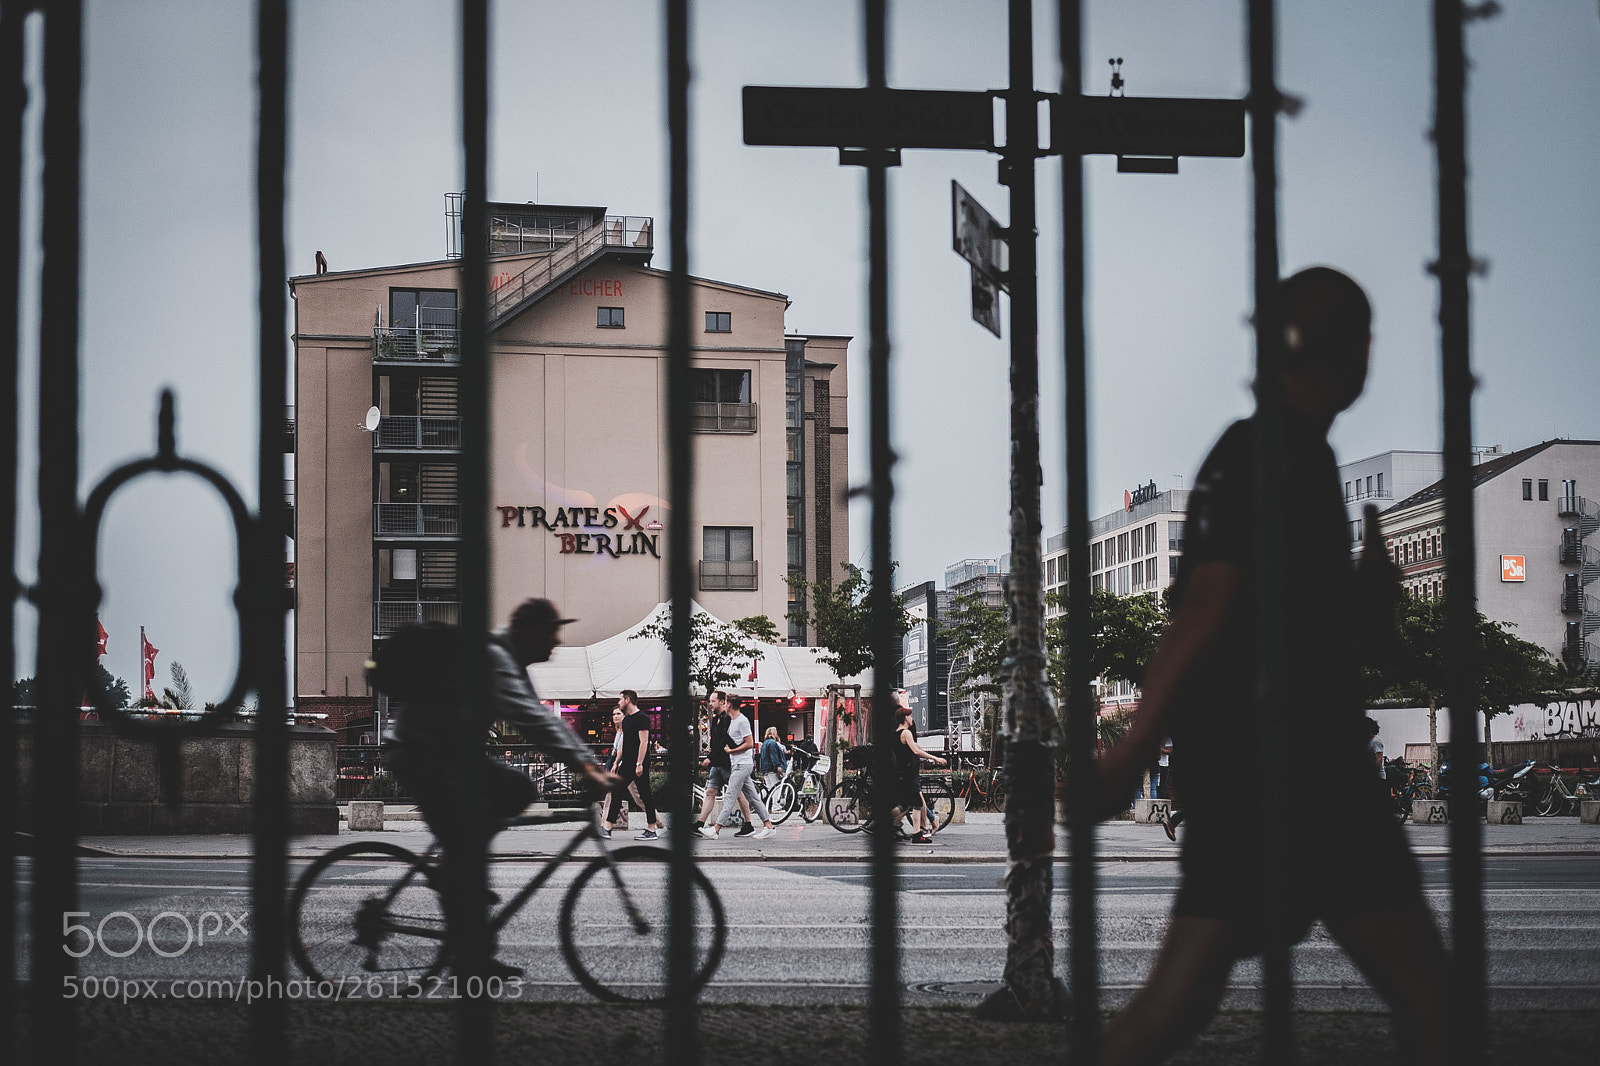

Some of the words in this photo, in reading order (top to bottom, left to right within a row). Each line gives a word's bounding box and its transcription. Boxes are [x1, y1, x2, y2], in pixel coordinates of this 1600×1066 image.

[766, 101, 974, 130] Oberbaubrücke
[497, 506, 619, 531] PIRATES
[554, 532, 661, 559] BERLIN
[1503, 559, 1524, 577] BSR
